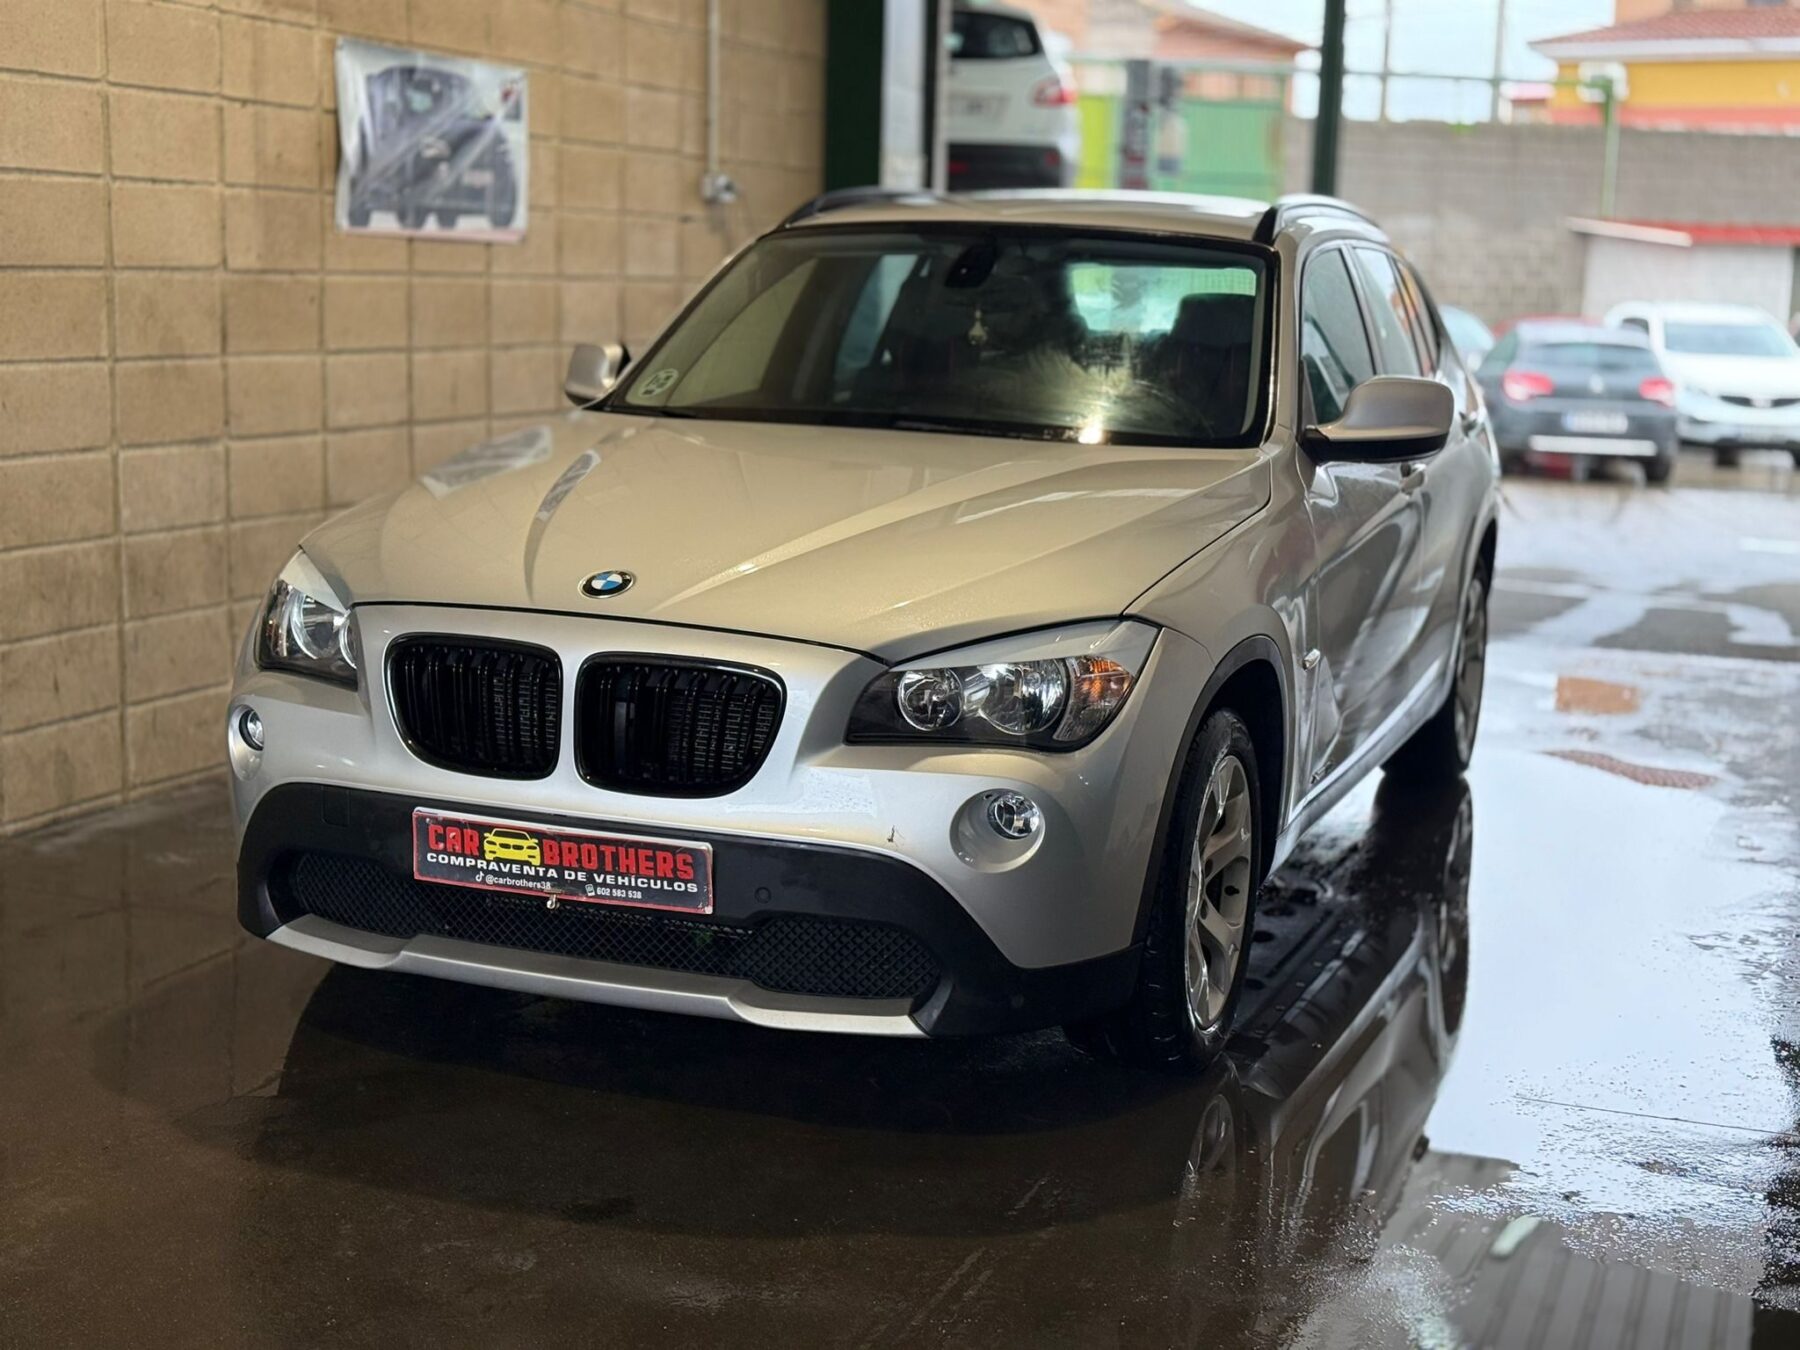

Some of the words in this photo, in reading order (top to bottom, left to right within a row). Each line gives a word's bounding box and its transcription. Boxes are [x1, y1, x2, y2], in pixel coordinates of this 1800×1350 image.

[428, 824, 480, 856] CAR
[542, 839, 694, 879] BROTHERS
[427, 852, 558, 878] COMPRAVENTA
[564, 870, 587, 881] DE
[593, 873, 698, 893] VEHÍCULOS
[485, 874, 551, 889] @carbrothers38
[596, 887, 610, 896] 602
